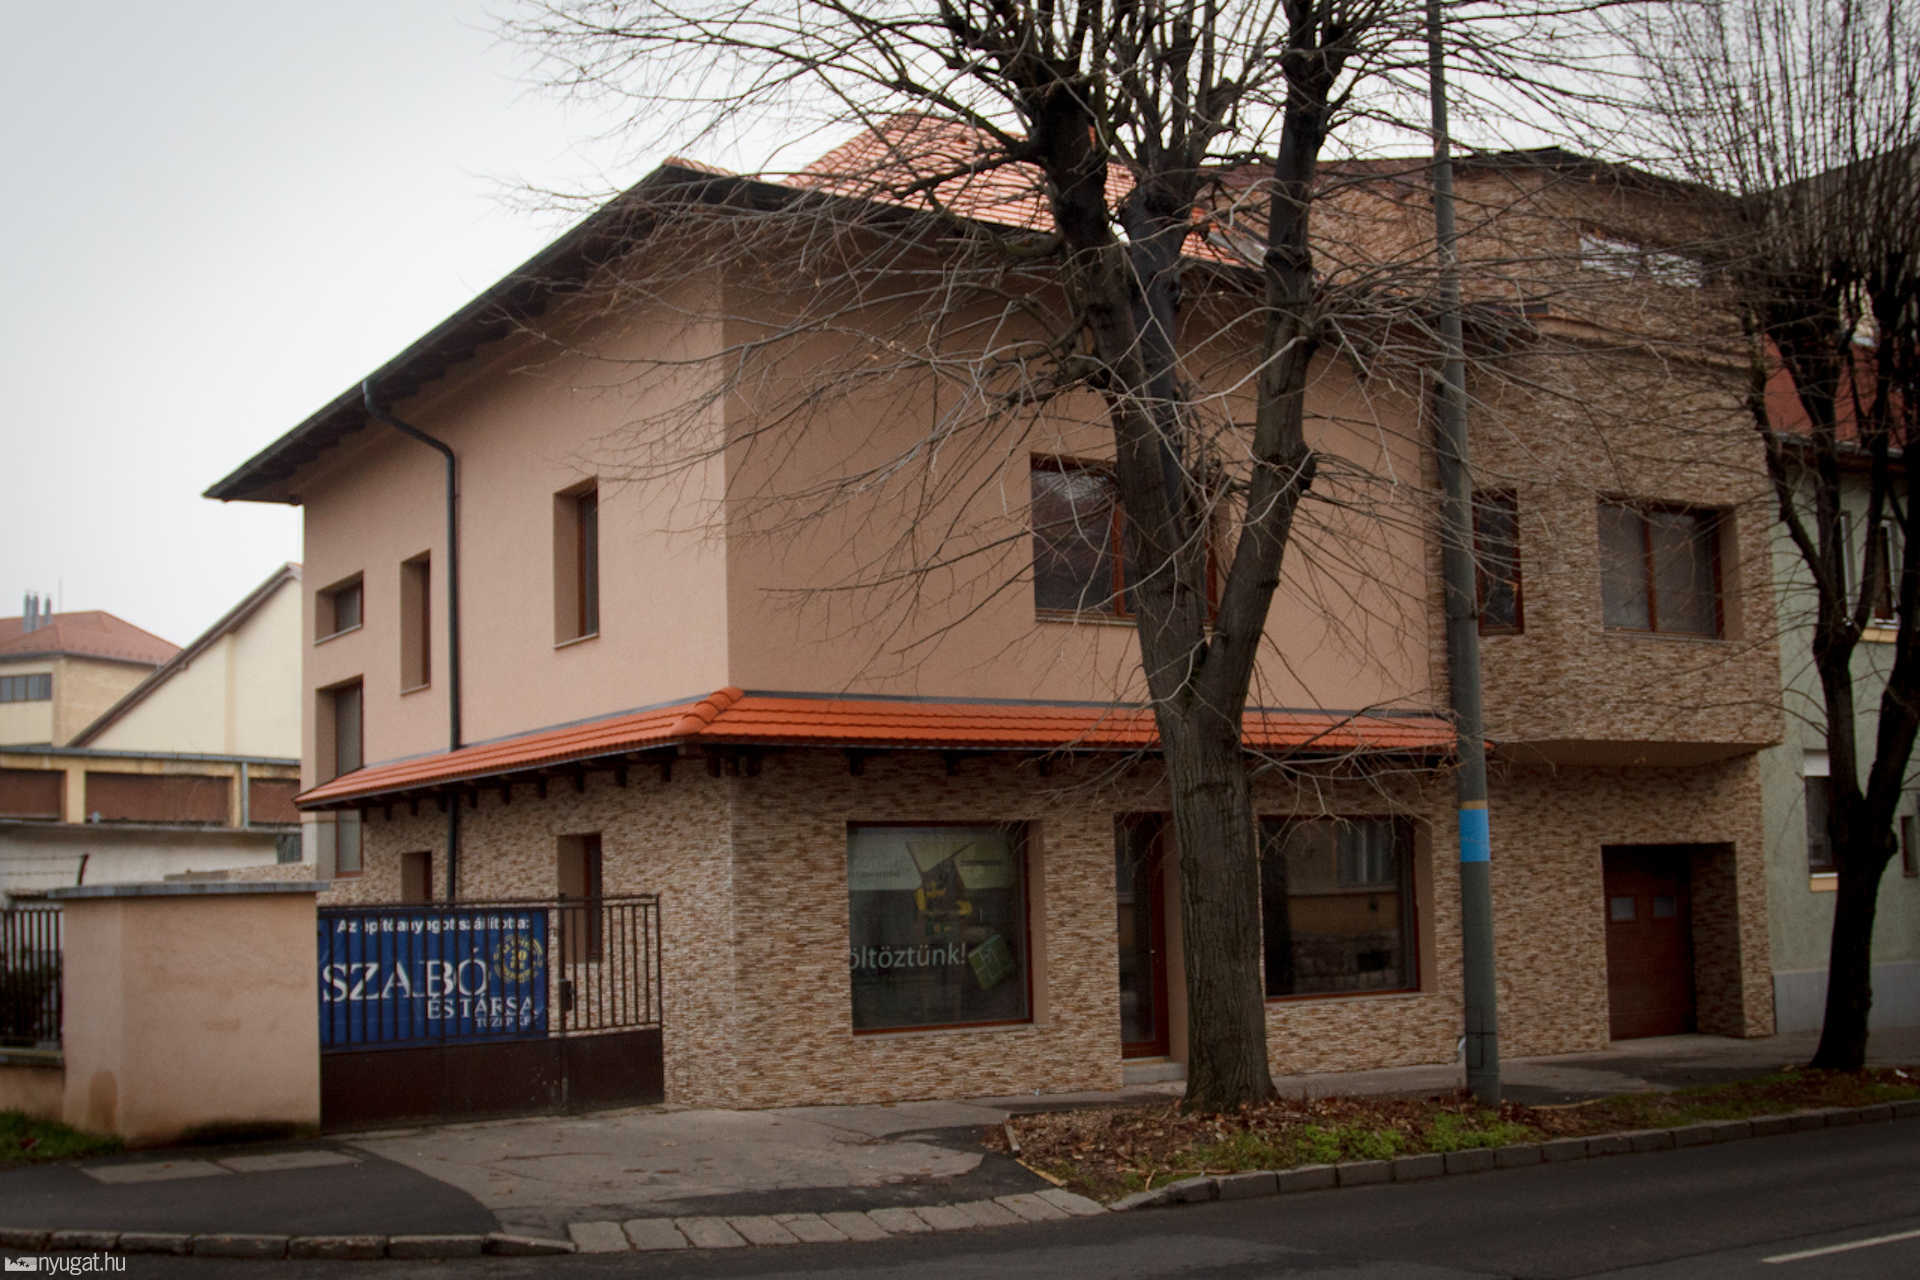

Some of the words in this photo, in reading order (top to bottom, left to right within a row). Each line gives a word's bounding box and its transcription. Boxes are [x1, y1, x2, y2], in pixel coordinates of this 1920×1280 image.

[336, 918, 357, 934] Az
[322, 947, 490, 1003] SZABÓ
[427, 994, 455, 1019] ÉS
[459, 992, 539, 1019] TÁRSA
